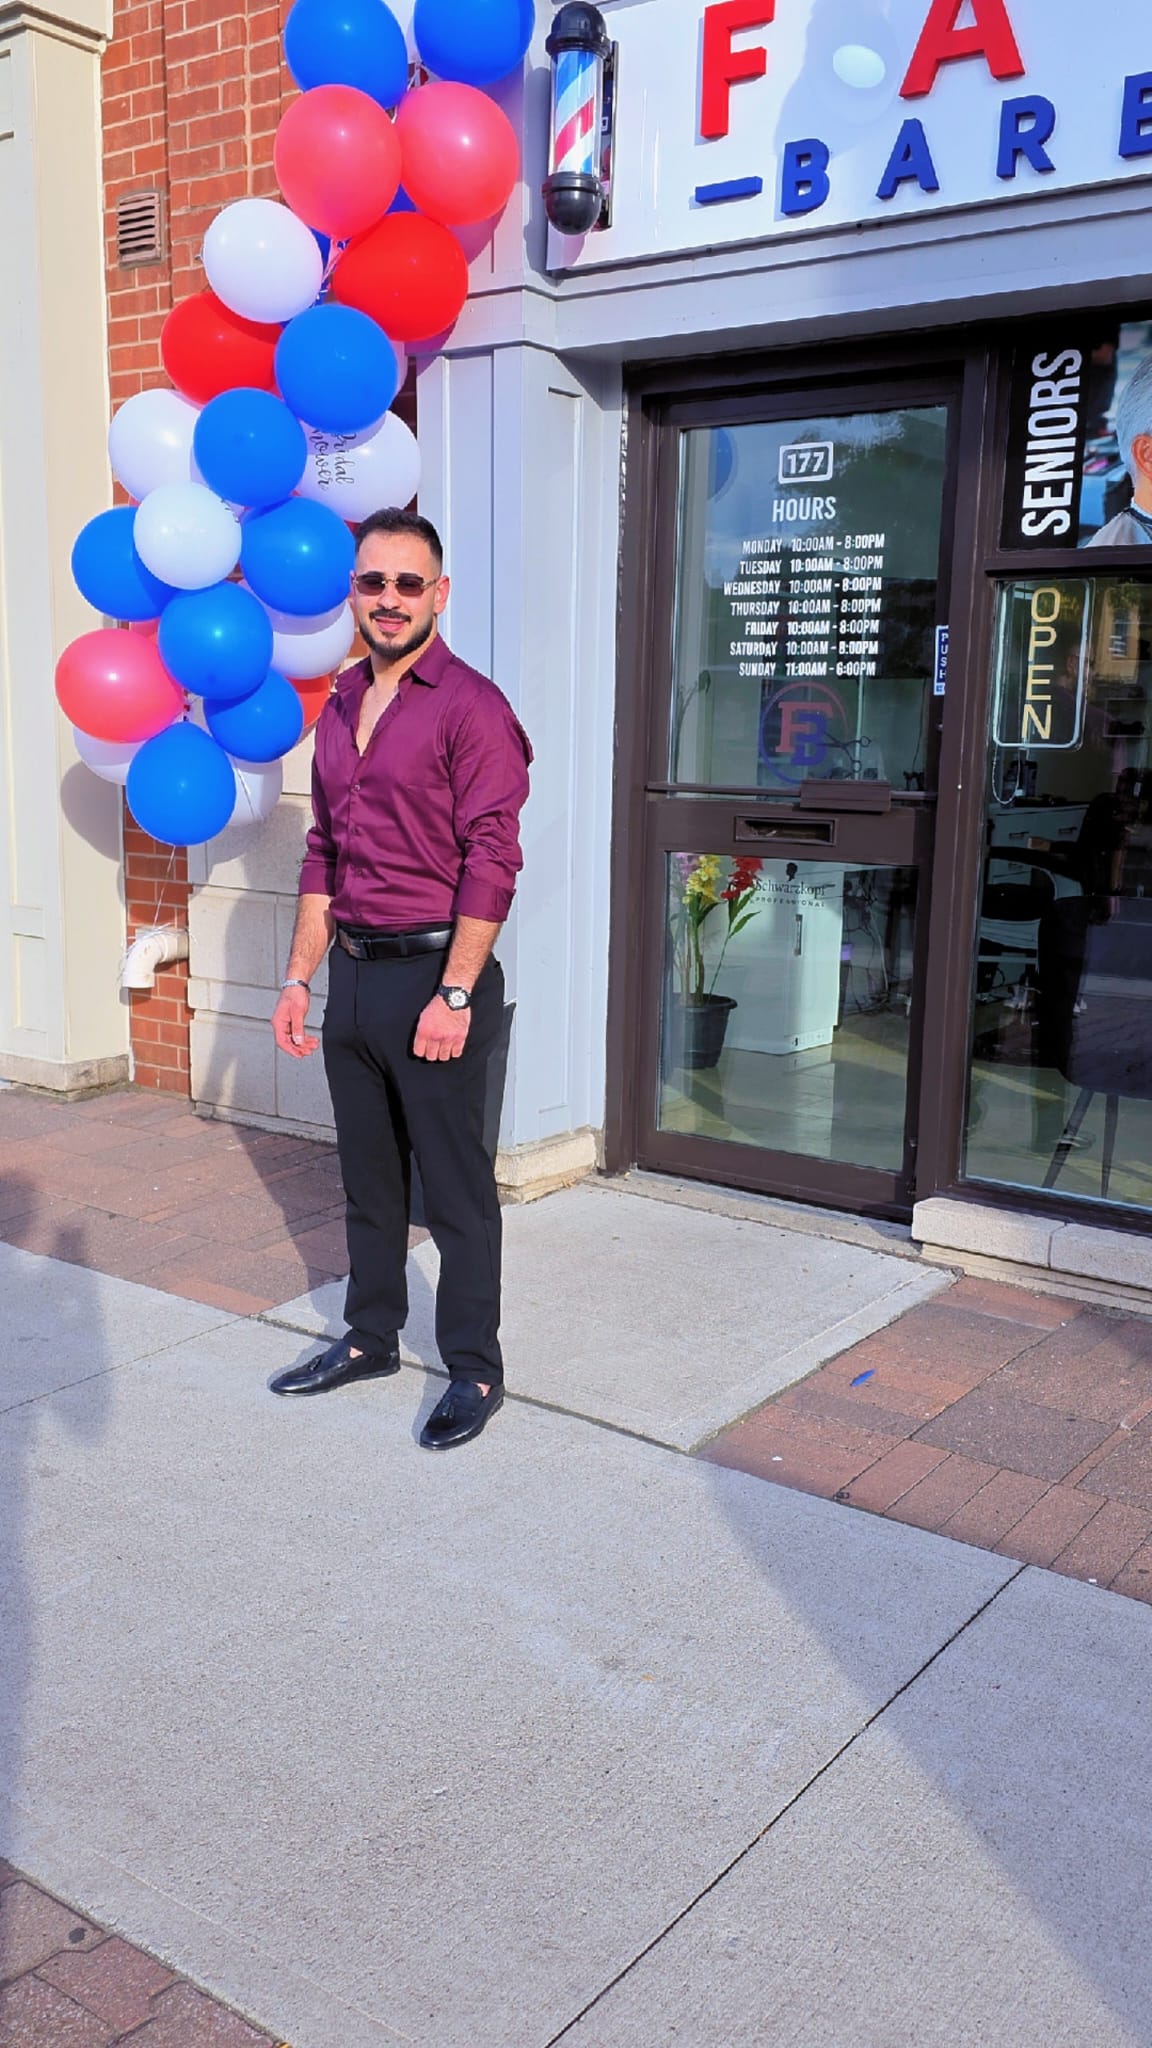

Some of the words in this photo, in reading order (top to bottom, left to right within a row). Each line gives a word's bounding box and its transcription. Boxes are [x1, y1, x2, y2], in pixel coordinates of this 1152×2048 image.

[1021, 349, 1083, 537] SENIORS
[787, 451, 825, 474] 177
[771, 496, 837, 522] HOURS
[742, 538, 783, 555] MONDAY
[791, 536, 834, 551] 10:00AM
[844, 533, 885, 549] 8:00PM
[740, 560, 782, 575] TUESDAY
[790, 558, 833, 573] 10:00AM
[843, 555, 883, 570] 8:00PM
[723, 580, 781, 596] WEDNESDAY
[788, 579, 832, 593] 10:00AM
[842, 577, 882, 591] 8:00PM
[730, 601, 780, 616] THURSDAY
[788, 599, 831, 614] 10:00AM
[841, 598, 881, 613] 8:00PM
[745, 622, 779, 636] FRIDAY
[787, 620, 830, 635] 10:00AM
[839, 619, 880, 634] 8:00PM
[730, 642, 778, 657] SATURDAY
[786, 641, 829, 656] 10:00AM
[838, 640, 879, 655] 8:00PM
[739, 662, 777, 677] SUNDAY
[785, 662, 827, 676] 11:00AM
[836, 661, 876, 676] 6:00PM
[1021, 587, 1061, 740] OPEN
